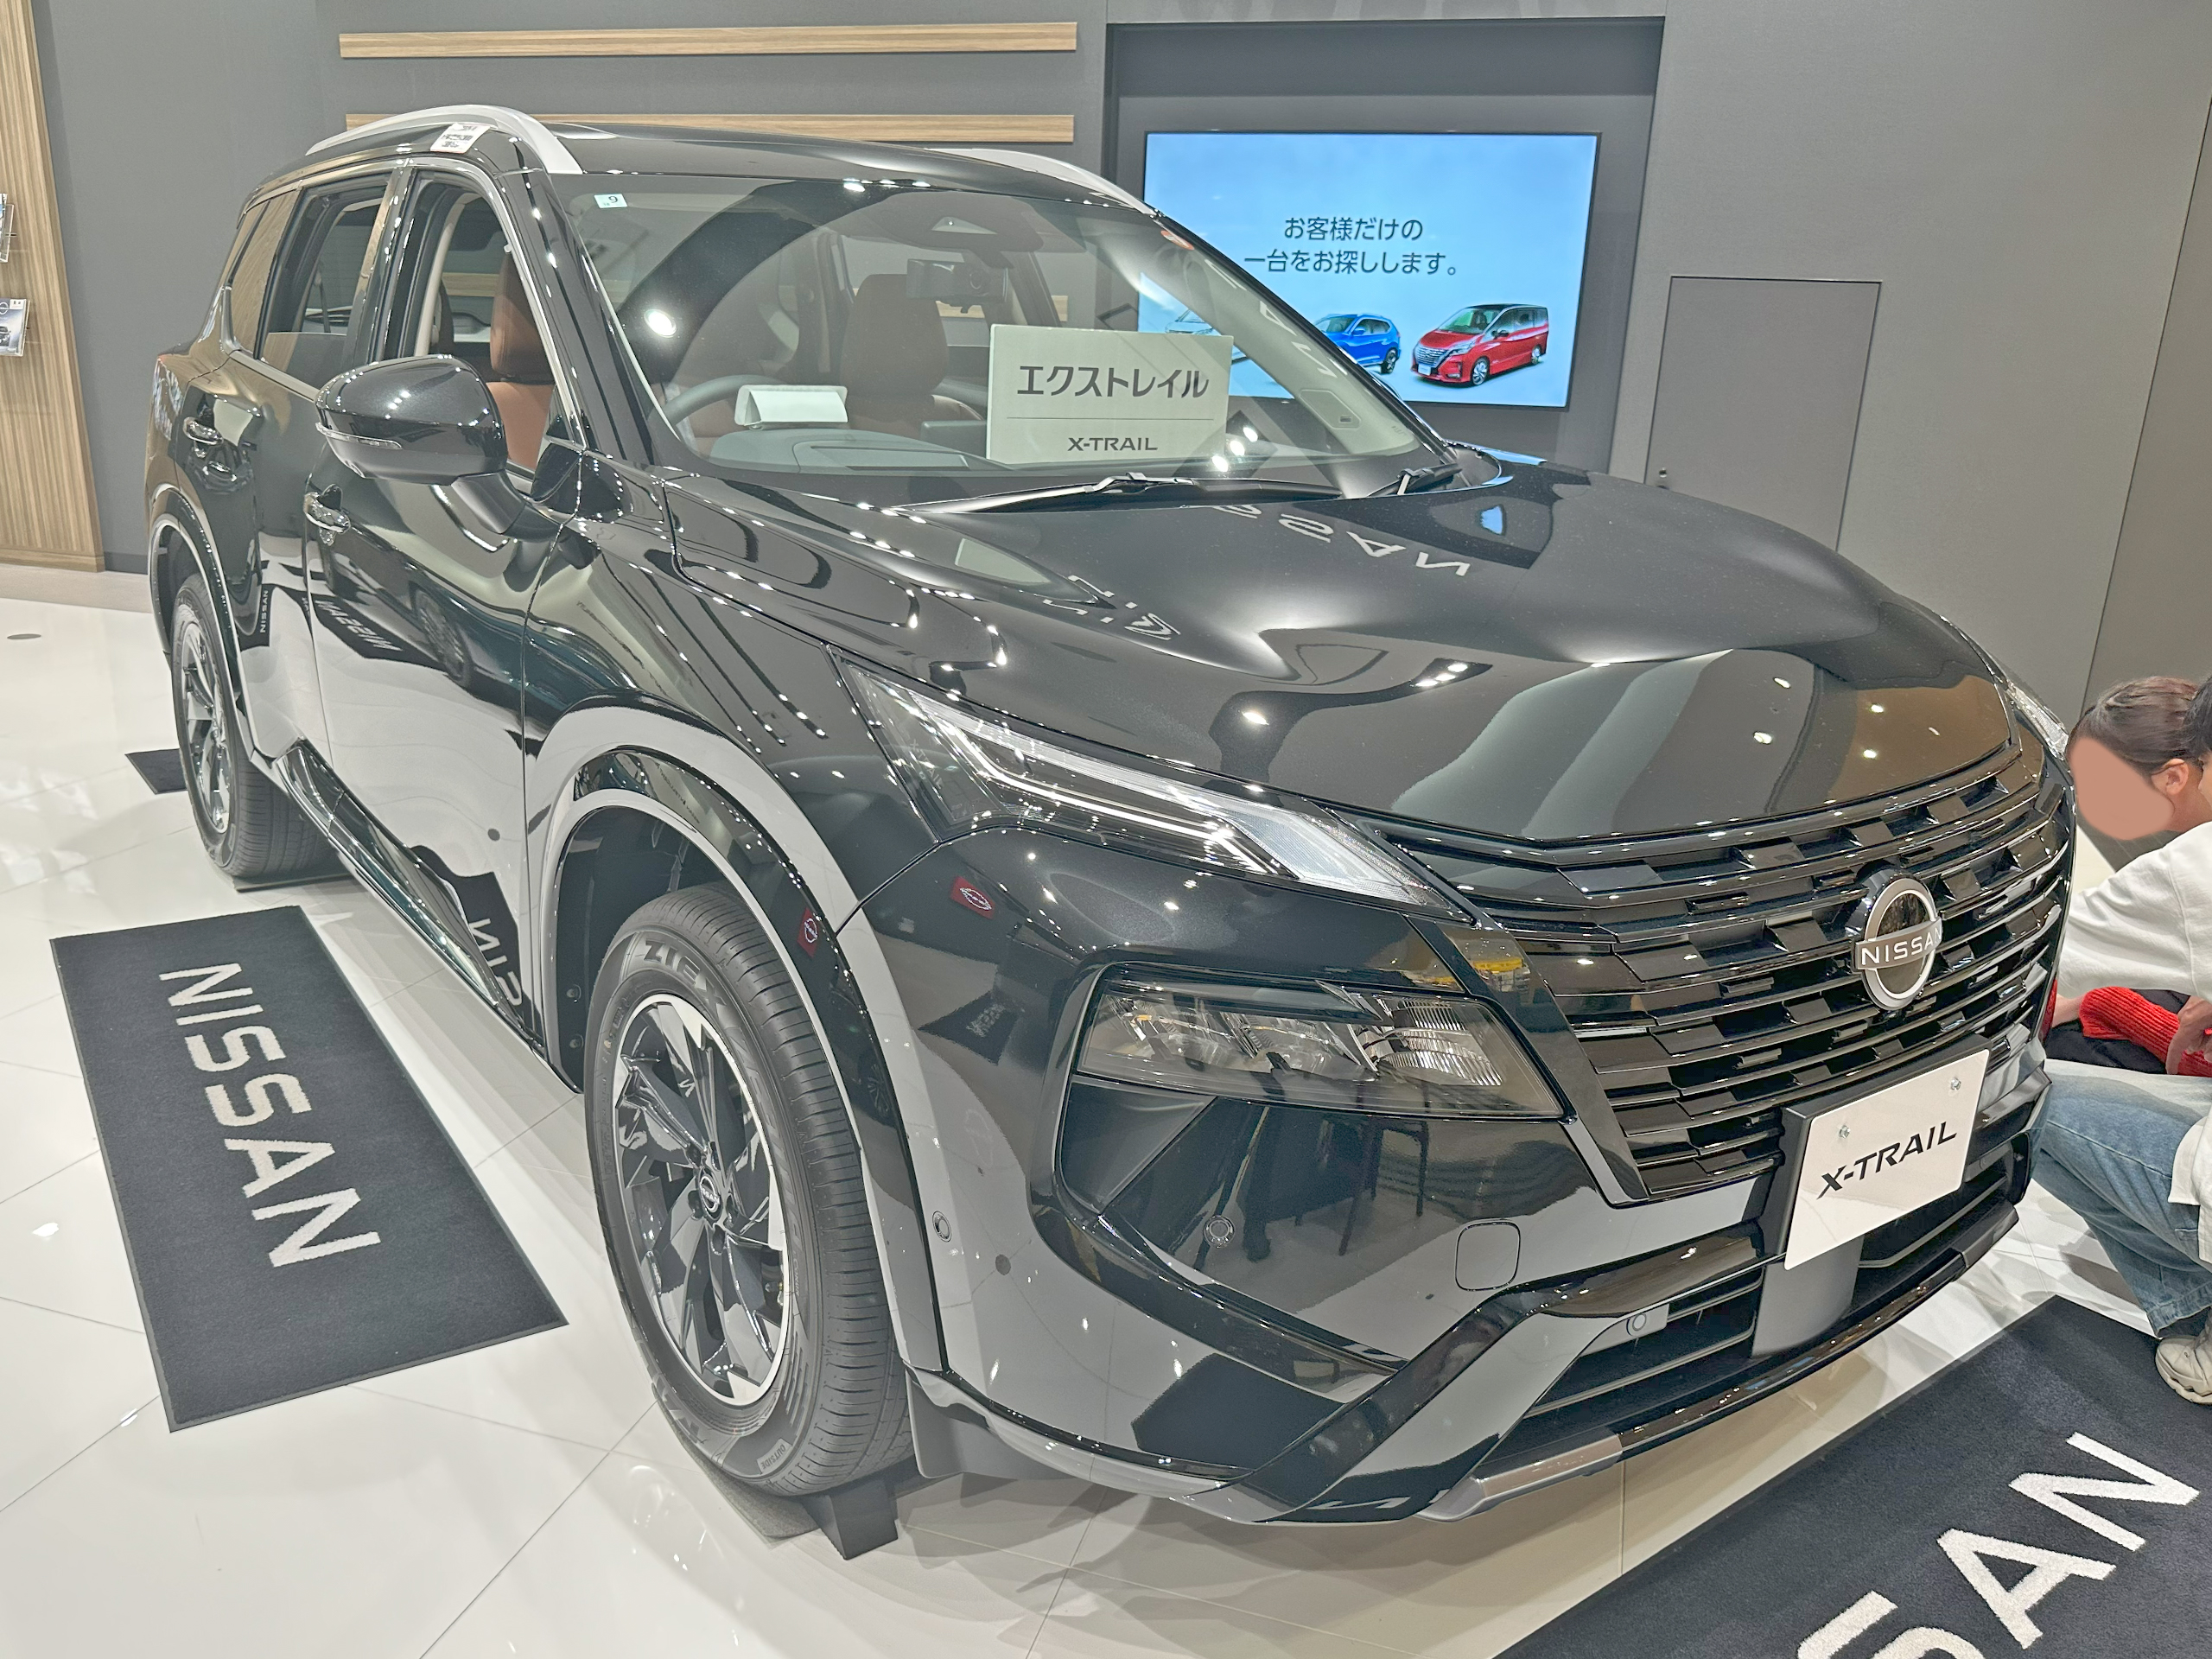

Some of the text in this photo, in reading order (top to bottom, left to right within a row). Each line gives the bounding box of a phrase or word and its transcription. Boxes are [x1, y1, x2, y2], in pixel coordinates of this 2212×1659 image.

[1284, 216, 1424, 241] お客様だけの
[1243, 249, 1457, 276] 一台をお探しします。
[1017, 365, 1210, 398] エクストレイル
[1067, 437, 1159, 452] X-TRAIL
[910, 739, 944, 790] X-TAIL
[1860, 925, 1942, 966] NISSAN
[643, 939, 728, 1018] ZIEX
[159, 962, 382, 1268] NISSAN
[1815, 1121, 1958, 1200] X-TRAIL
